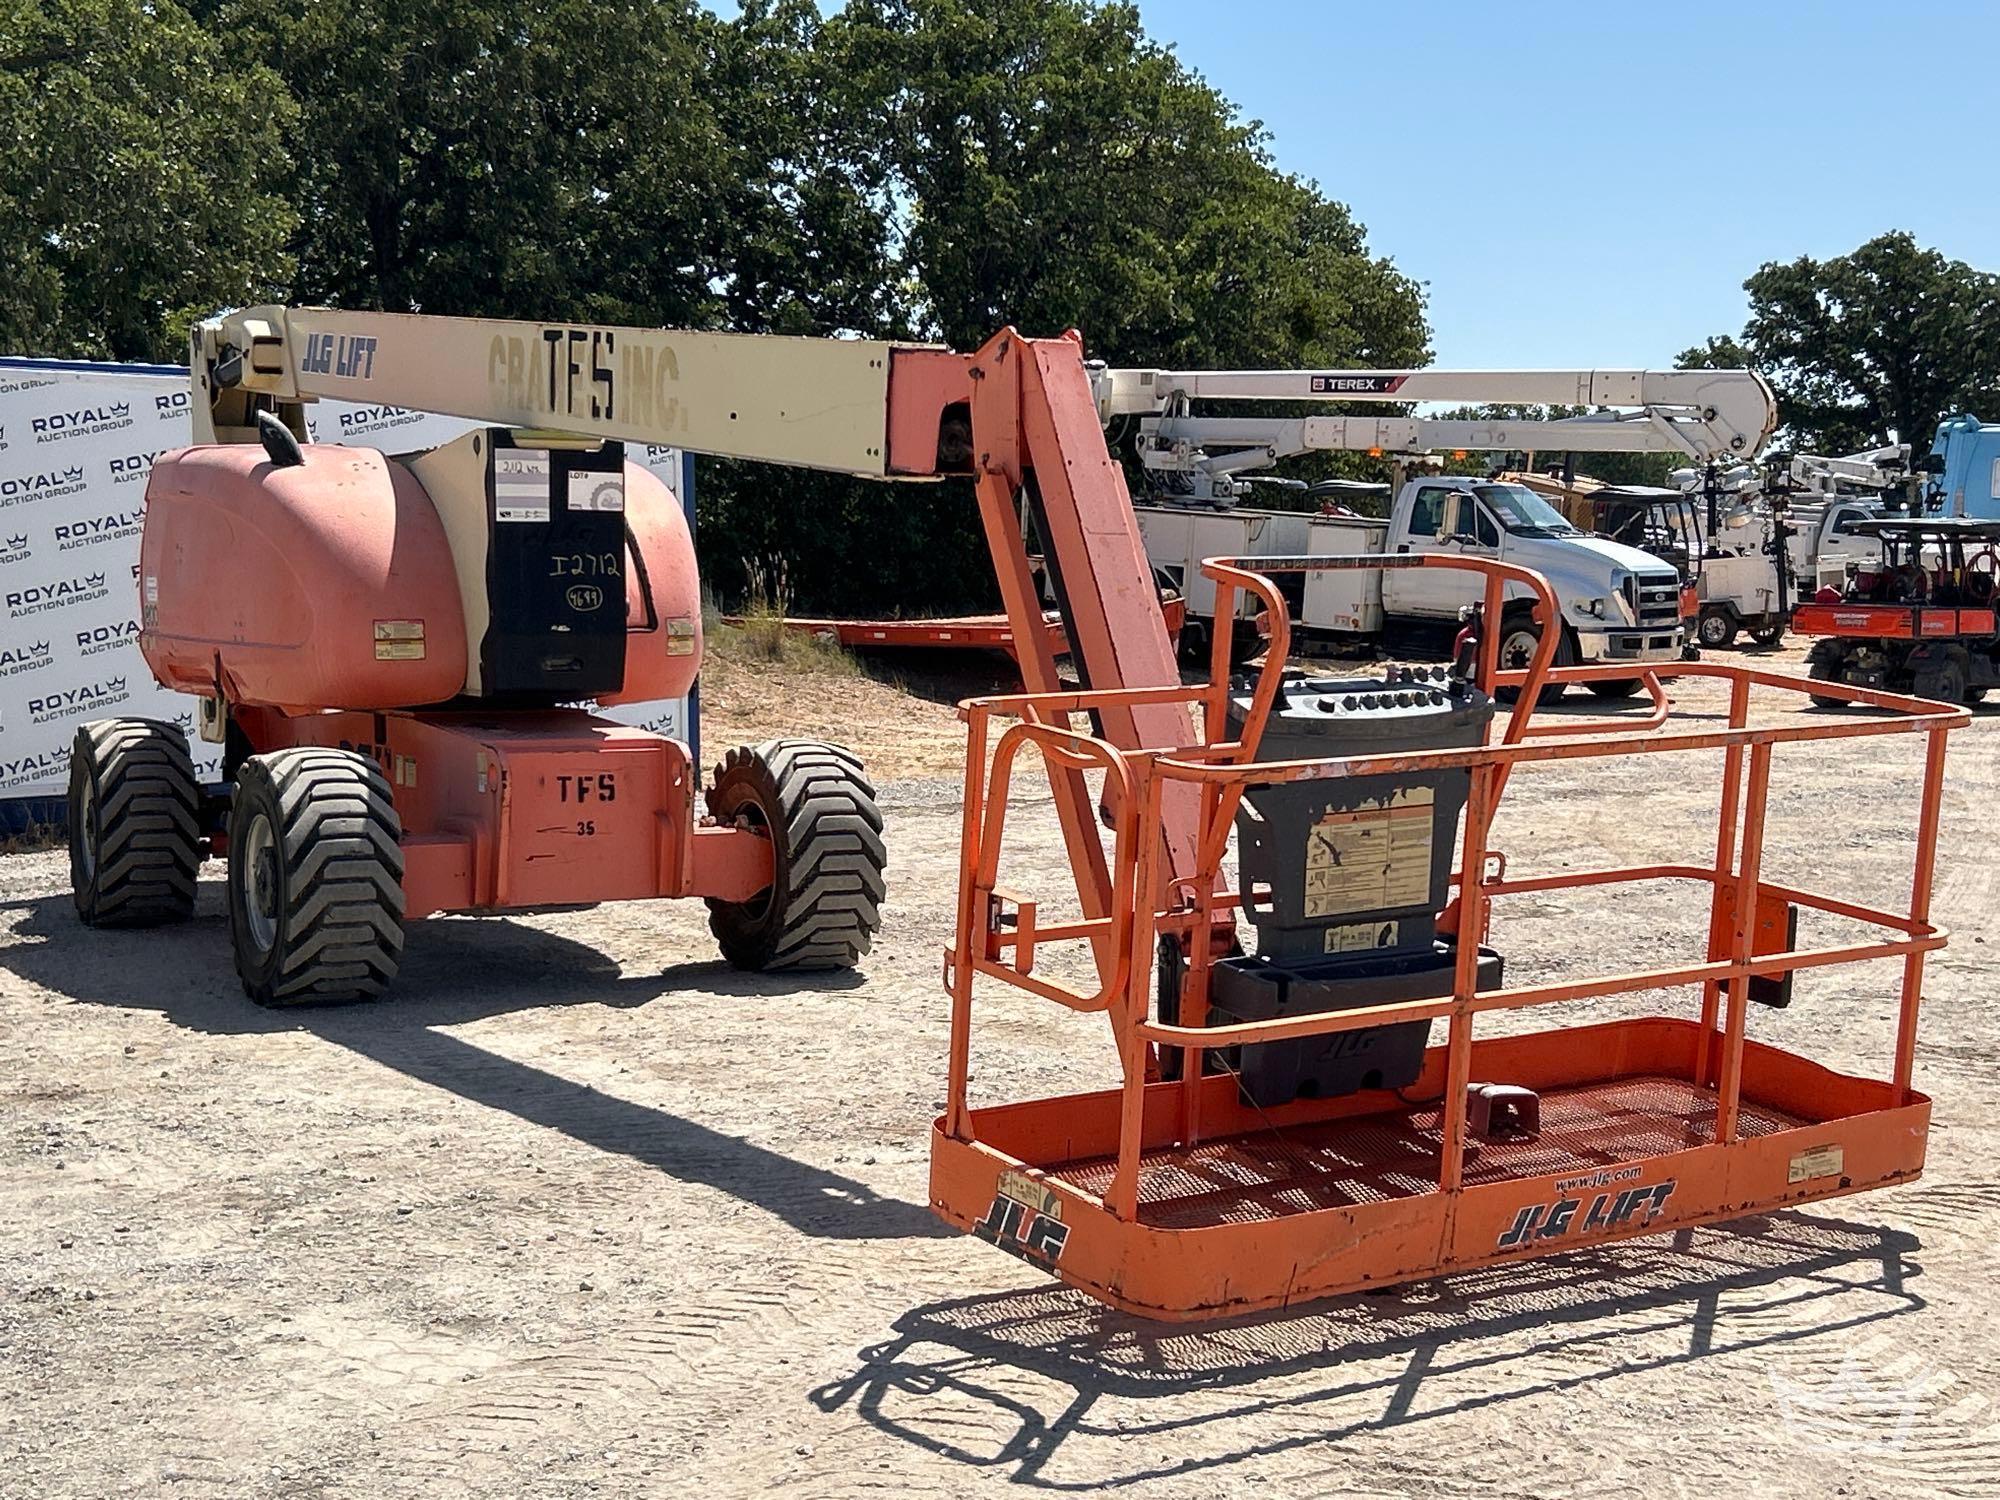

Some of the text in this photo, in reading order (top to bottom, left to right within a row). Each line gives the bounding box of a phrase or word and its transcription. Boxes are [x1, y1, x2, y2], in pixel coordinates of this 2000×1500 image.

[301, 332, 379, 380] JLG LIFT
[1328, 378, 1376, 390] TEREX
[32, 407, 110, 433] ROYAL
[36, 418, 133, 444] AUCTION GROUP
[343, 414, 425, 437] AUCTION GROUP
[110, 450, 167, 474] ROY
[1, 472, 64, 495] OYAL
[114, 470, 149, 484] AUCTI
[0, 483, 87, 508] UCTION GROUP
[55, 513, 132, 540] ROYAL
[59, 526, 143, 551] AUCTION GRO
[0, 550, 31, 564] ROUP
[6, 579, 86, 608] ROYAL
[10, 588, 109, 619] AUCTION GROUP
[76, 620, 141, 647] ROYA
[80, 638, 133, 657] AUCTION
[10, 657, 54, 674] GROUP
[28, 683, 108, 714] ROYAL
[33, 692, 130, 724] AUCTION GROUP
[0, 754, 51, 779] YAL
[0, 774, 30, 789] TION
[556, 774, 615, 803] TFS
[1556, 1166, 1642, 1191] www.jlg.com
[1581, 1179, 1679, 1232] LIFT
